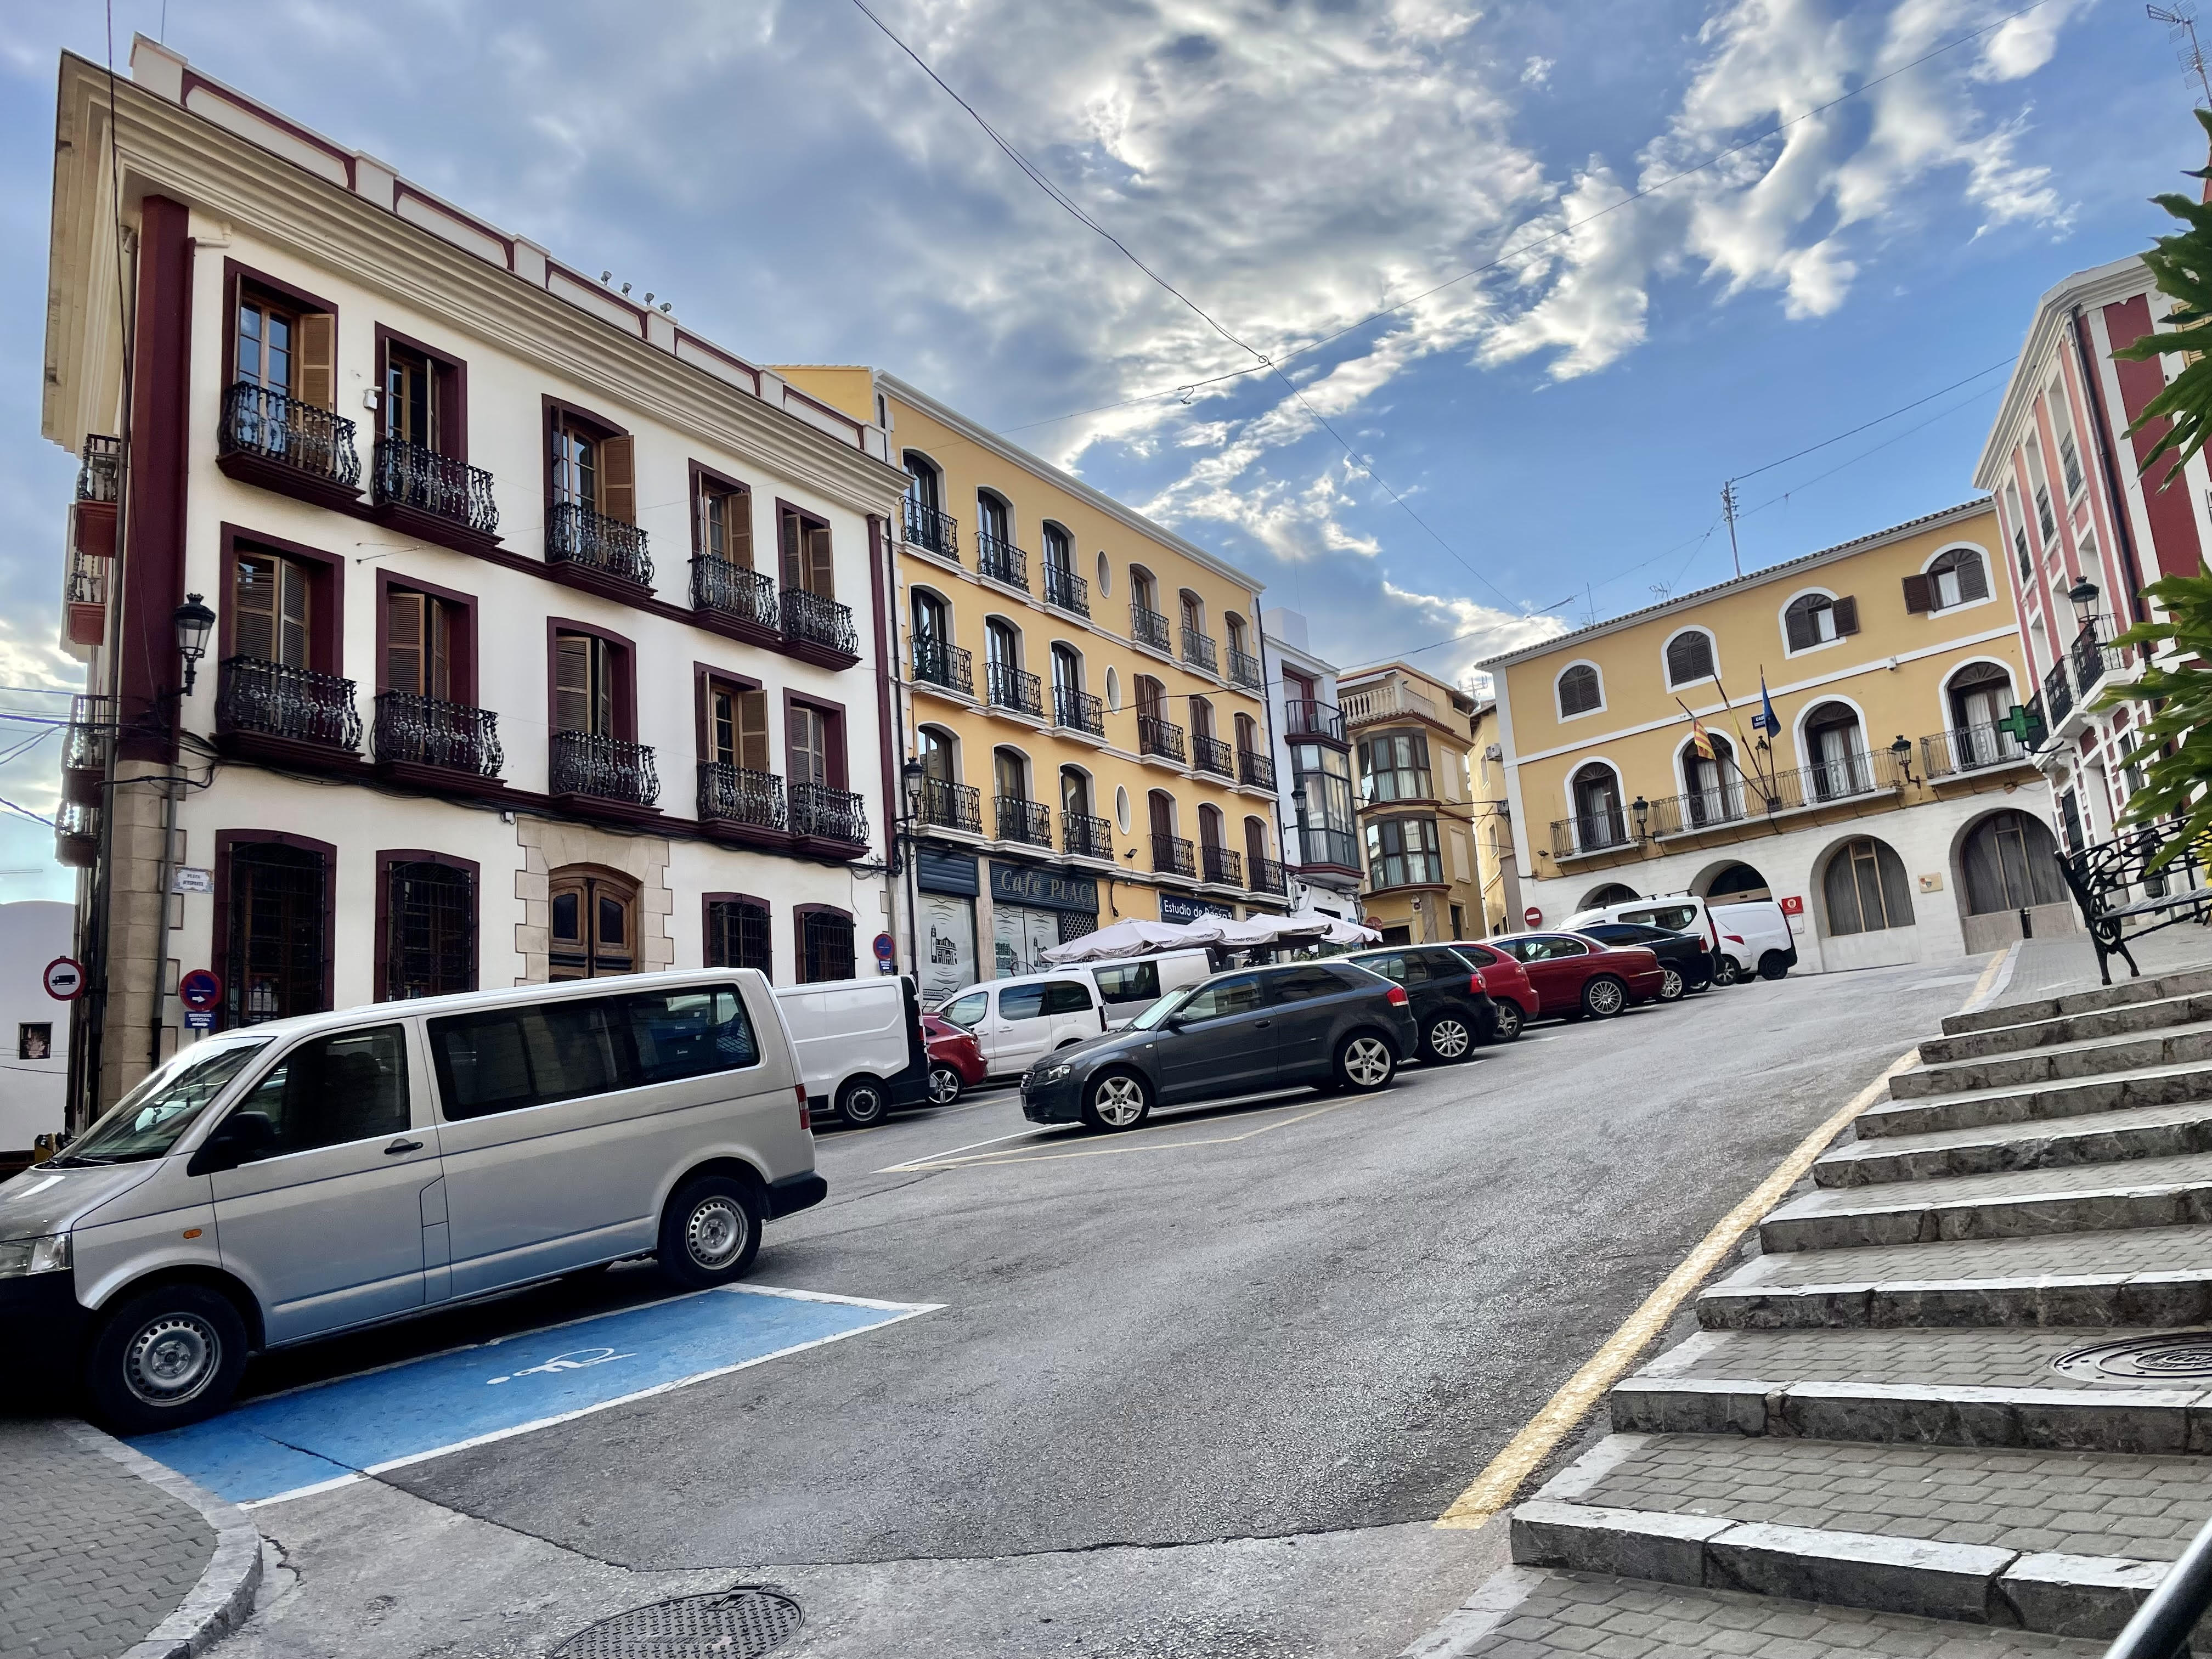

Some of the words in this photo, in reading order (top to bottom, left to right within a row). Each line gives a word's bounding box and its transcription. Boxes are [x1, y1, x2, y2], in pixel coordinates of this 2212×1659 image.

[1001, 871, 1040, 898] Café
[1050, 878, 1097, 908] PLAÇA
[1164, 899, 1191, 916] Estudio
[1193, 906, 1203, 917] de
